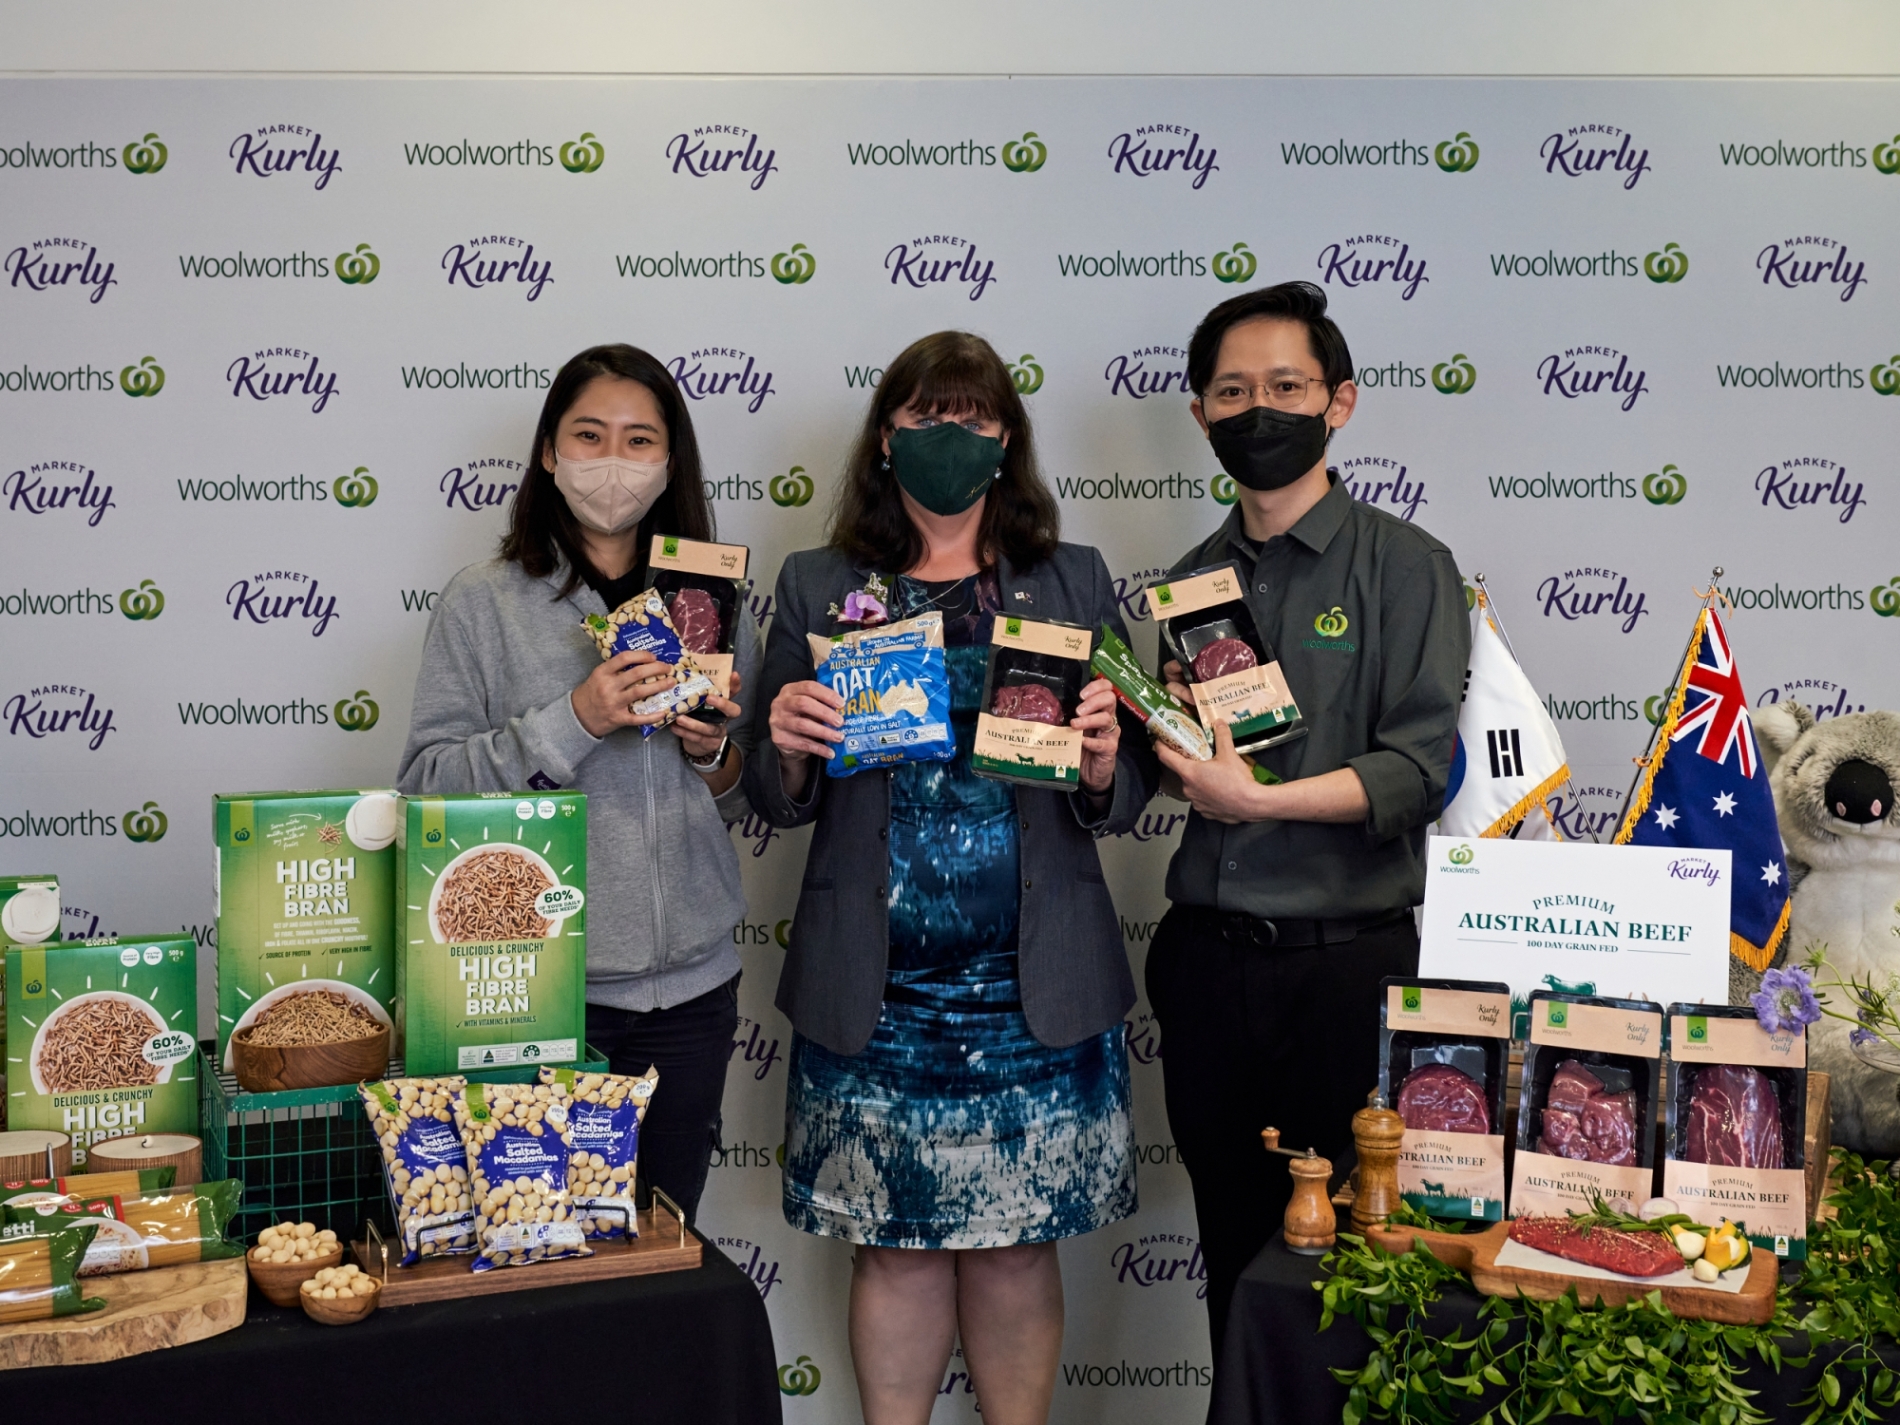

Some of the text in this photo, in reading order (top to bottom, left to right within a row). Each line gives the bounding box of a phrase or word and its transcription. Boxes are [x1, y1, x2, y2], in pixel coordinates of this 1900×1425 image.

[257, 124, 312, 137] MARKET
[693, 124, 748, 137] MARKET
[1135, 123, 1190, 136] MARKET
[1567, 124, 1622, 137] MARKET
[404, 138, 554, 166] Woolworths
[847, 138, 996, 166] Woolworths
[1280, 138, 1430, 166] Woolworths
[1719, 139, 1868, 166] Woolworths
[228, 134, 342, 190] Kurly
[664, 134, 778, 190] Kurly
[1106, 132, 1220, 190] Kurly
[1538, 134, 1652, 190] Kurly
[32, 237, 87, 250] MARKET
[469, 235, 524, 248] MARKET
[912, 235, 967, 248] MARKET
[1345, 234, 1400, 247] MARKET
[1783, 235, 1838, 248] MARKET
[179, 250, 328, 278] Woolworths
[616, 250, 766, 278] Woolworths
[1057, 249, 1206, 276] Woolworths
[1489, 249, 1638, 276] Woolworths
[4, 246, 118, 304] Kurly
[440, 244, 554, 302] Kurly
[884, 244, 998, 302] Kurly
[1316, 244, 1430, 300] Kurly
[1754, 244, 1868, 302] Kurly
[254, 347, 309, 360] MARKET
[691, 347, 746, 360] MARKET
[1564, 345, 1619, 358] MARKET
[401, 361, 550, 388] Woolworths
[1716, 360, 1866, 388] Woolworths
[226, 356, 340, 414] Kurly
[1536, 354, 1650, 412] Kurly
[31, 460, 86, 473] MARKET
[468, 457, 523, 470] MARKET
[1343, 456, 1398, 469] MARKET
[1782, 457, 1837, 470] MARKET
[178, 473, 328, 500] Woolworths
[440, 467, 517, 511] Kur
[1056, 472, 1206, 500] Woolworths
[1488, 471, 1638, 498] Woolworths
[2, 469, 116, 527] Kurly
[1754, 466, 1868, 524] Kurly
[720, 553, 738, 562] Kurly
[721, 560, 736, 570] Only
[254, 571, 309, 584] MARKET
[1564, 567, 1619, 580] MARKET
[1212, 579, 1230, 588] Kurly
[1216, 586, 1230, 594] Only
[226, 580, 340, 638] Kurly
[1536, 576, 1650, 634] Kurly
[1064, 636, 1082, 646] Kurly
[1065, 644, 1080, 652] Only
[1302, 639, 1356, 652] Woolworths
[830, 656, 880, 671] AUSTRALIAN
[31, 684, 86, 697] MARKET
[833, 667, 874, 700] OAT
[1783, 679, 1838, 692] MARKET
[178, 697, 328, 724] Woolworths
[3, 693, 116, 750] Kurly
[888, 721, 902, 730] SALT
[1046, 740, 1070, 748] BEEF
[276, 857, 356, 884] HIGH
[1440, 866, 1480, 874] Woolworths
[1667, 860, 1721, 887] Kurly
[284, 882, 348, 900] FIBRE
[544, 890, 573, 904] 60%
[284, 898, 350, 918] BRAN
[1532, 895, 1616, 915] PREMIUM
[1458, 912, 1692, 942] AUSTRALIAN BEEF
[450, 942, 544, 956] DELICIOUS & CRUNCHY
[1526, 940, 1618, 953] 100 DAY GRAIN FED
[266, 951, 284, 959] SOURCE
[292, 950, 311, 958] PROTEIN
[460, 954, 537, 981] HIGH
[466, 978, 528, 998] FIBRE
[466, 996, 530, 1016] BRAN
[1477, 1004, 1500, 1017] Kurly
[464, 1019, 477, 1027] WITH
[479, 1018, 504, 1026] VITAMINS
[510, 1016, 536, 1024] MINERALS
[1479, 1015, 1497, 1026] Only
[1626, 1022, 1649, 1034] Kurly
[152, 1035, 183, 1050] 60%
[1627, 1033, 1646, 1045] Only
[1770, 1034, 1794, 1044] Kurly
[1771, 1044, 1791, 1056] Only
[54, 1089, 153, 1108] DELICIOUS & CRUNCHY
[64, 1102, 146, 1132] HIGH
[577, 1116, 612, 1124] Australian
[575, 1123, 612, 1132] Salted
[422, 1136, 456, 1146] Salted
[1414, 1142, 1452, 1153] PREMIUM
[494, 1154, 558, 1164] Macadamias
[506, 1148, 543, 1157] Salted
[1398, 1151, 1487, 1167] STRALIAN BEEF
[1561, 1171, 1600, 1184] PREMIUM
[1712, 1178, 1754, 1190] PREMIUM
[1676, 1185, 1790, 1204] AUSTRALIAN BEEF
[1139, 1234, 1194, 1247] MARKET
[1063, 1360, 1211, 1387] Woolworths
